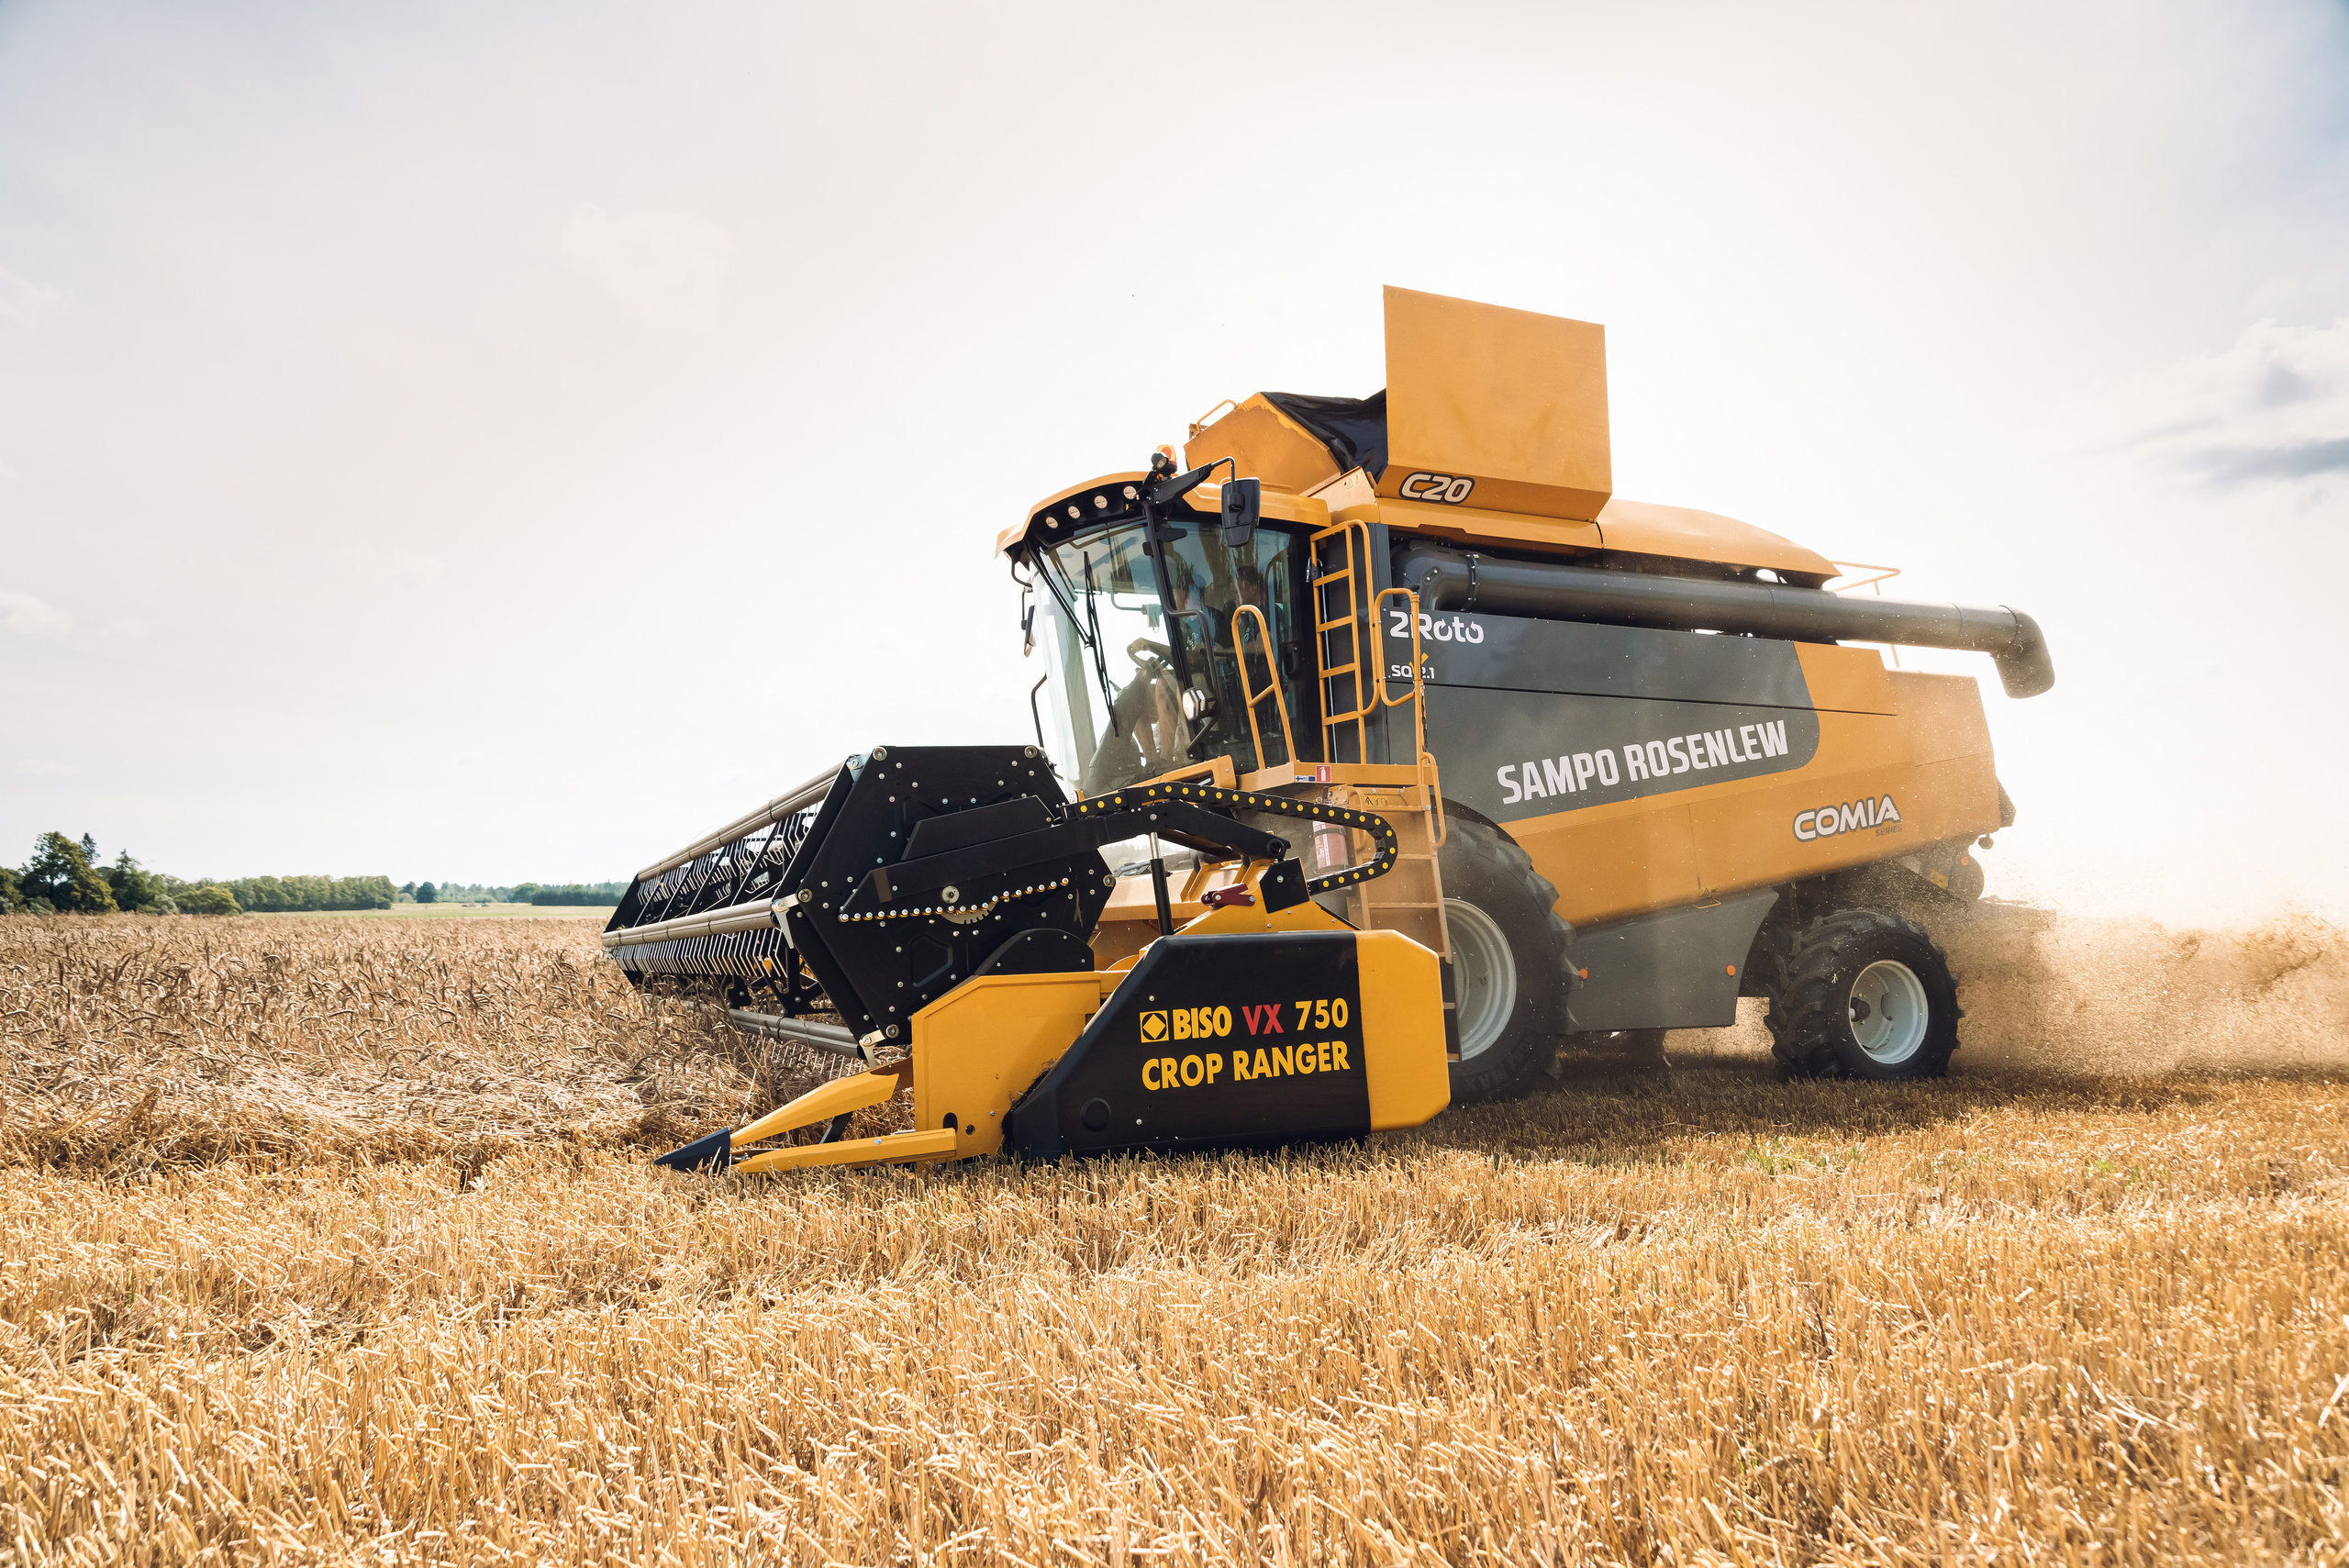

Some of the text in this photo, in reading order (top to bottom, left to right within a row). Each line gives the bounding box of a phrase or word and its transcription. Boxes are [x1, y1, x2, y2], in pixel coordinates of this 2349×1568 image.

[1399, 472, 1475, 504] C20
[1497, 720, 1788, 805] SAMPO ROSENLEW
[1793, 794, 1901, 842] COMIA
[1875, 824, 1903, 837] SERIES
[1172, 997, 1349, 1040] BISO VX 750
[1141, 1040, 1351, 1091] CROP RANGER
